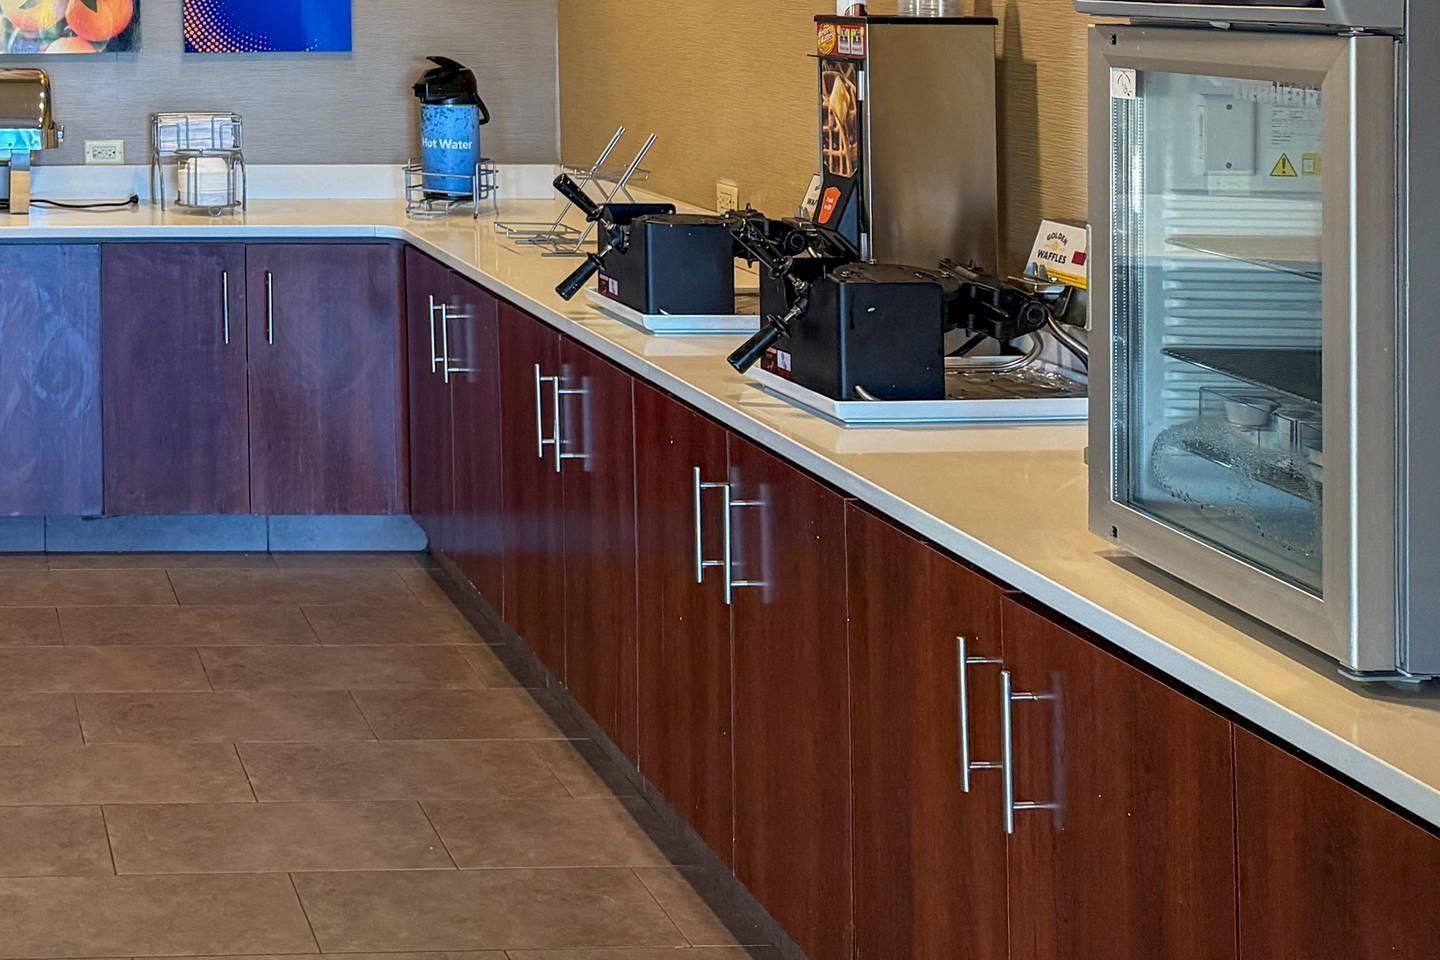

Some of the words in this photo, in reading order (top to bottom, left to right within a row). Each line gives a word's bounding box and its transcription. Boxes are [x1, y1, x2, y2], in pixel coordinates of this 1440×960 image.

[422, 137, 436, 148] Hot
[439, 139, 472, 149] Water
[1047, 232, 1068, 246] GOLDEN
[1037, 249, 1067, 264] WAFFLES
